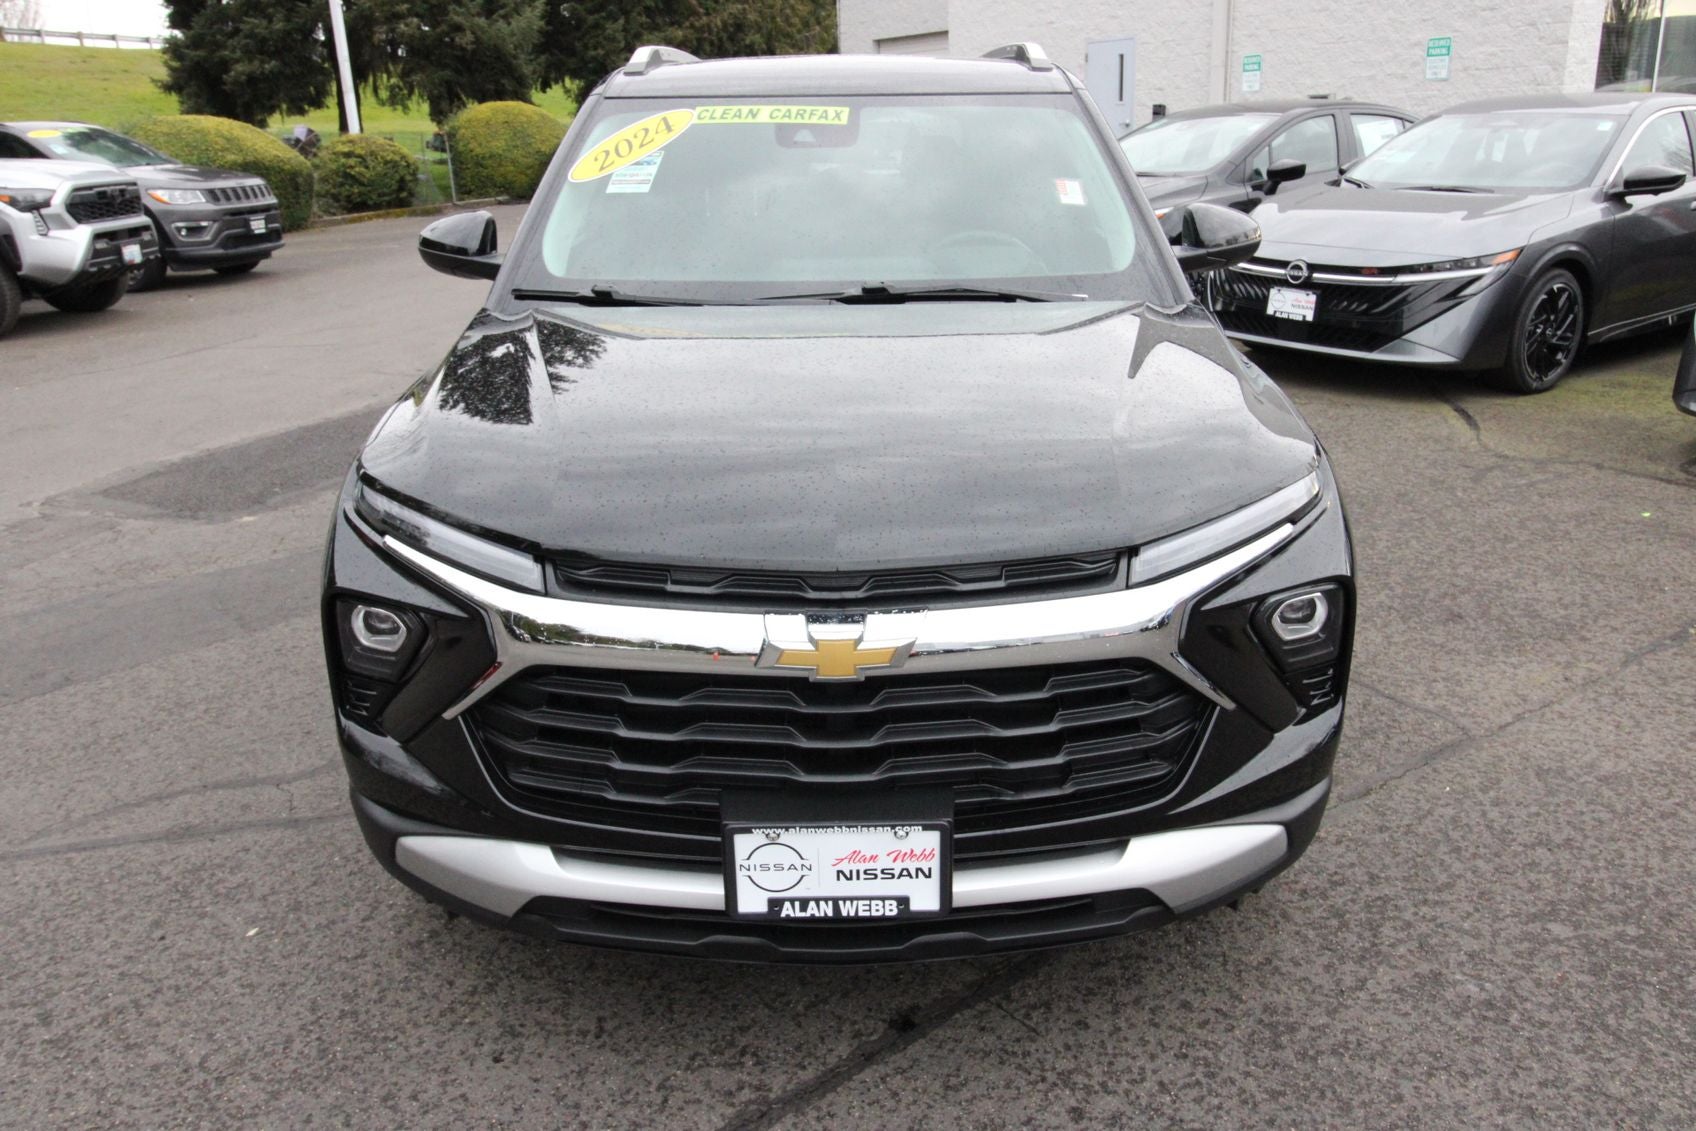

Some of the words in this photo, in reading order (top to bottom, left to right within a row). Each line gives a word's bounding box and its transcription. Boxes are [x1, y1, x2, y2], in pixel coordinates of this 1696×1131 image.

[1428, 47, 1448, 55] PARKING
[697, 108, 760, 121] CLEAN
[769, 109, 845, 122] CARFAX
[594, 115, 676, 172] 2024
[752, 824, 923, 835] www.alanwebbnissan.com
[831, 849, 880, 867] Alan
[886, 847, 937, 864] Webb
[739, 863, 812, 872] NISSAN
[836, 867, 932, 882] NISSAN
[780, 900, 834, 918] ALAN
[839, 899, 898, 917] WEBB
